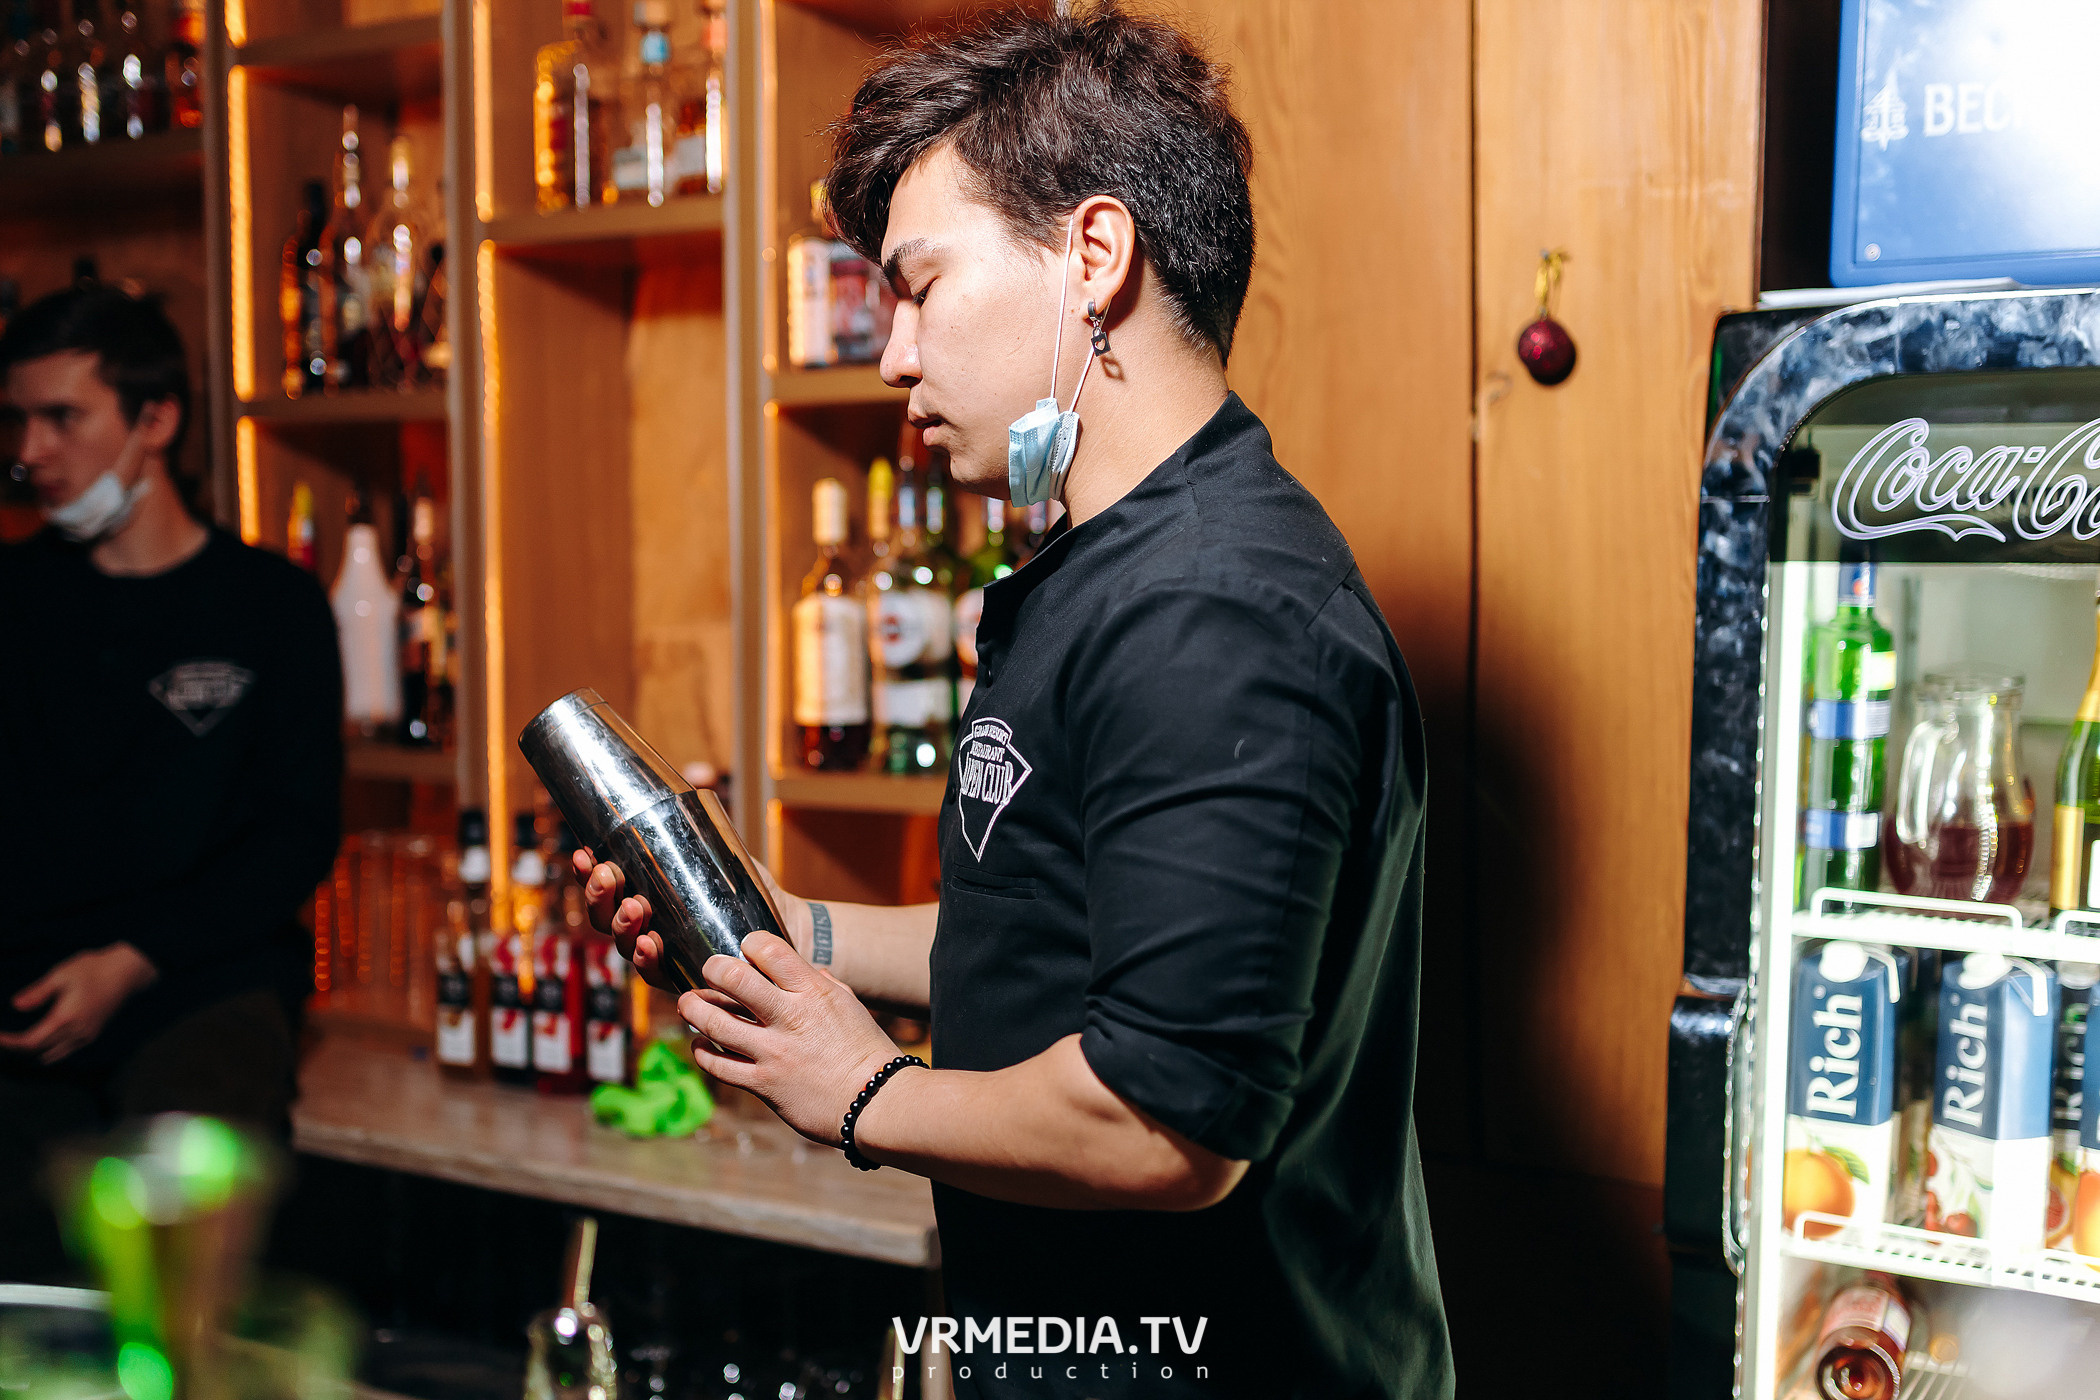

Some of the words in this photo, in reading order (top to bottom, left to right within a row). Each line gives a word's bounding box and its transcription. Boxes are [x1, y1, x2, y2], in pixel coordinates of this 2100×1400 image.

[982, 761, 1014, 806] CLUB
[1806, 994, 1862, 1119] Rich
[1942, 1003, 1989, 1128] Rich
